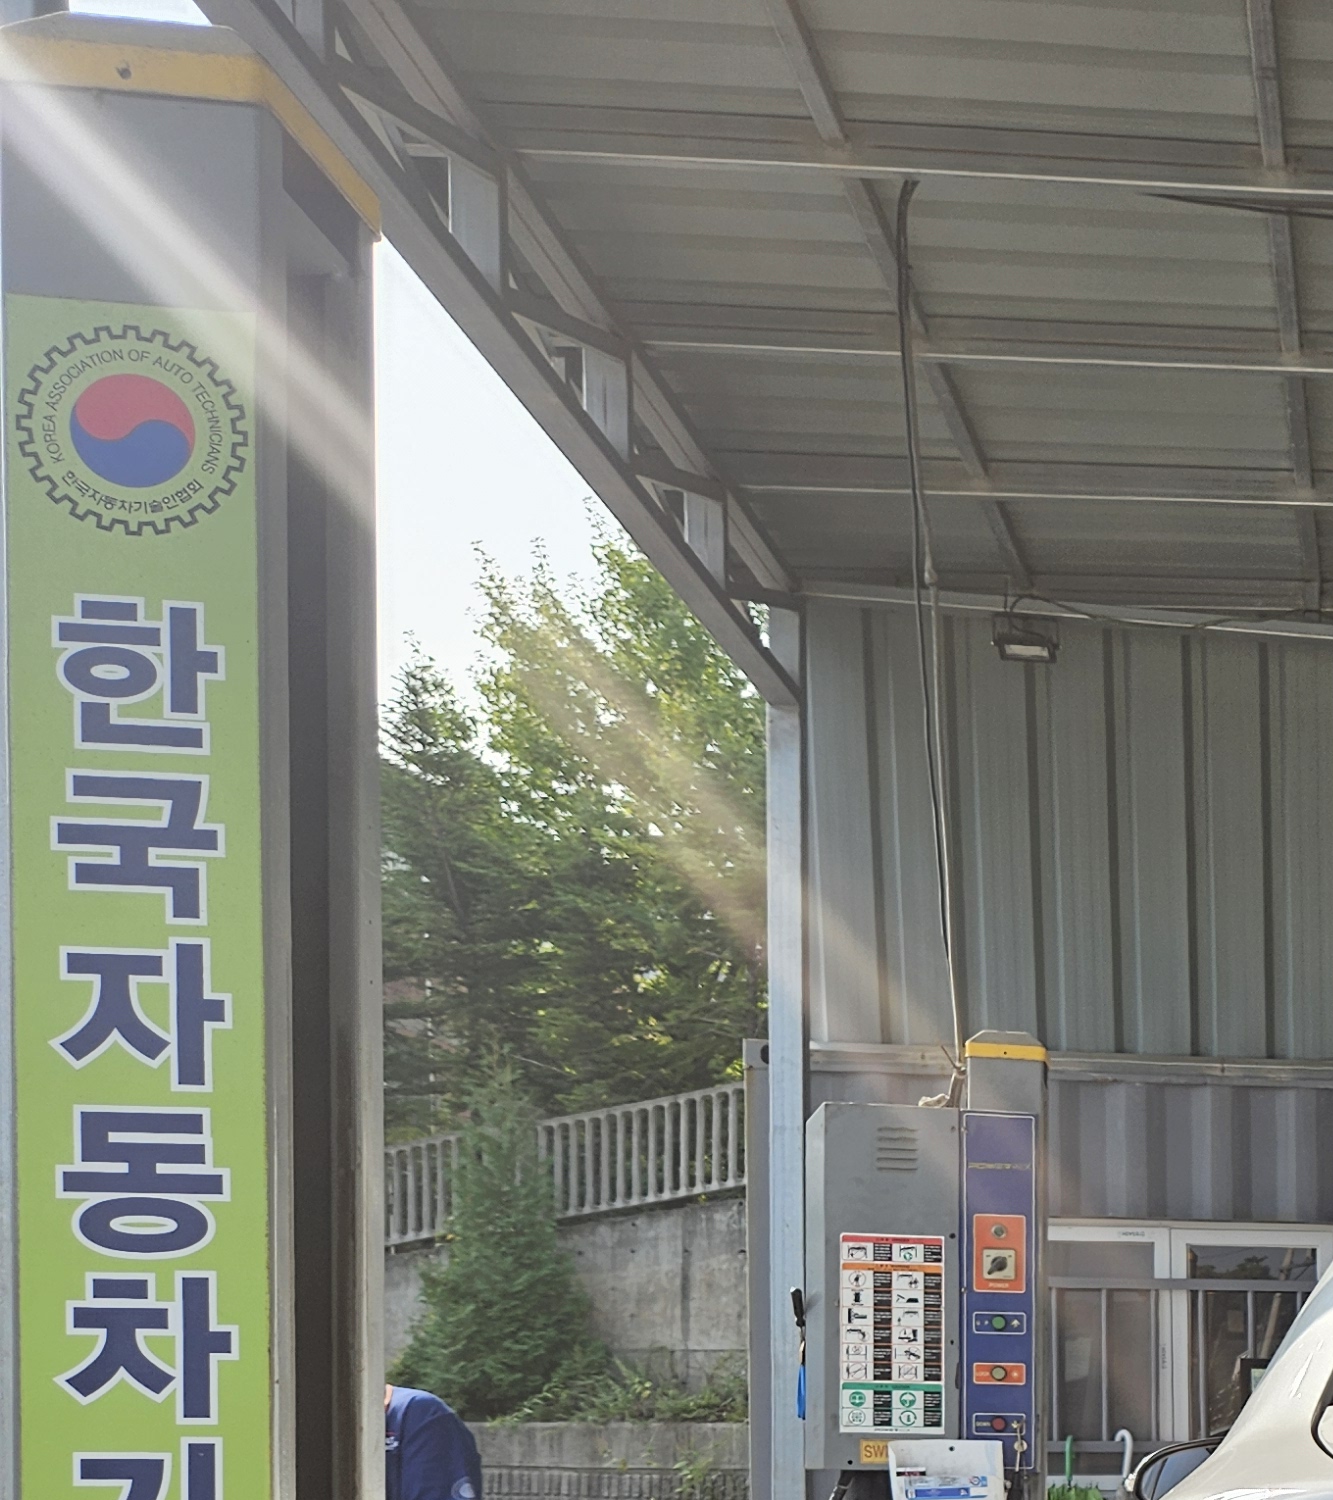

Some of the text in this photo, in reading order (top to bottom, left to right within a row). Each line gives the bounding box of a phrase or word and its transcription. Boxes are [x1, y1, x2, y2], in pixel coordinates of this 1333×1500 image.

[42, 349, 223, 474] KOREA ASSOCIATION OF AUTO TECHNICIANS
[62, 470, 204, 514] 한국자동차기술인협회
